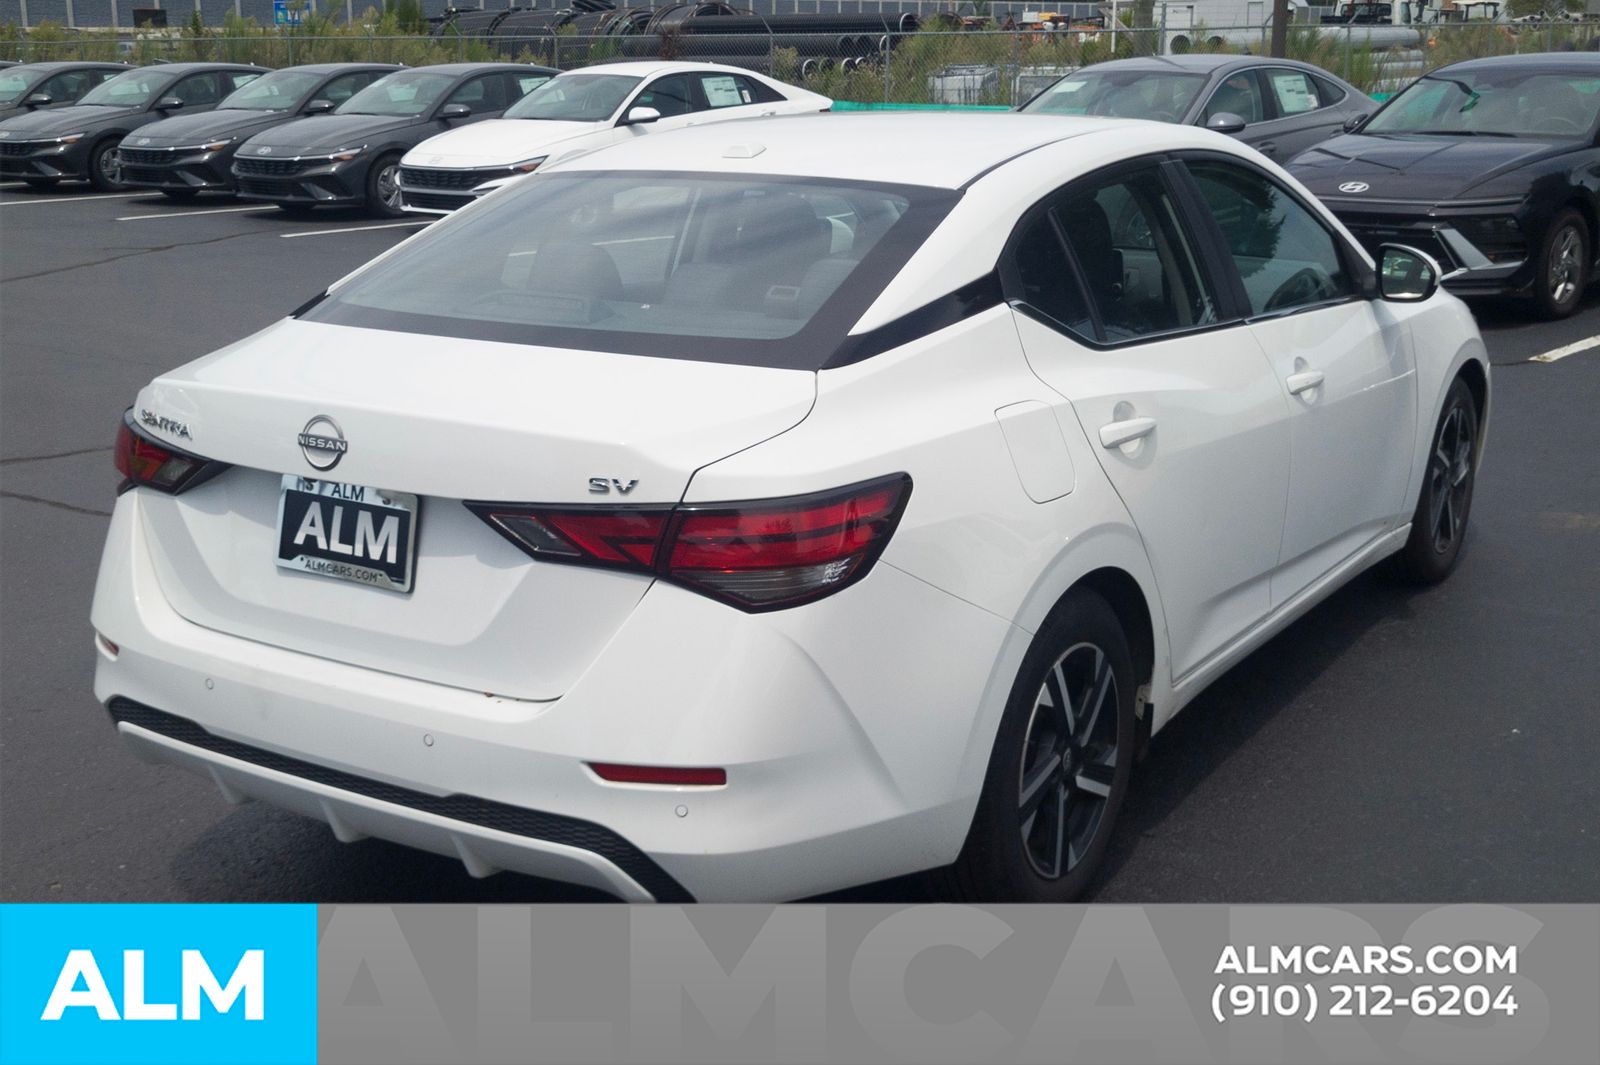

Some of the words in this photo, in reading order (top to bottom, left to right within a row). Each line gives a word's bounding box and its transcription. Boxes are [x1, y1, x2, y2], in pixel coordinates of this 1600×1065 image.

[299, 435, 346, 451] NISSAN
[331, 483, 365, 502] ALM
[588, 477, 639, 496] SV
[293, 501, 400, 564] ALM
[304, 559, 379, 583] ALMCARS.COM
